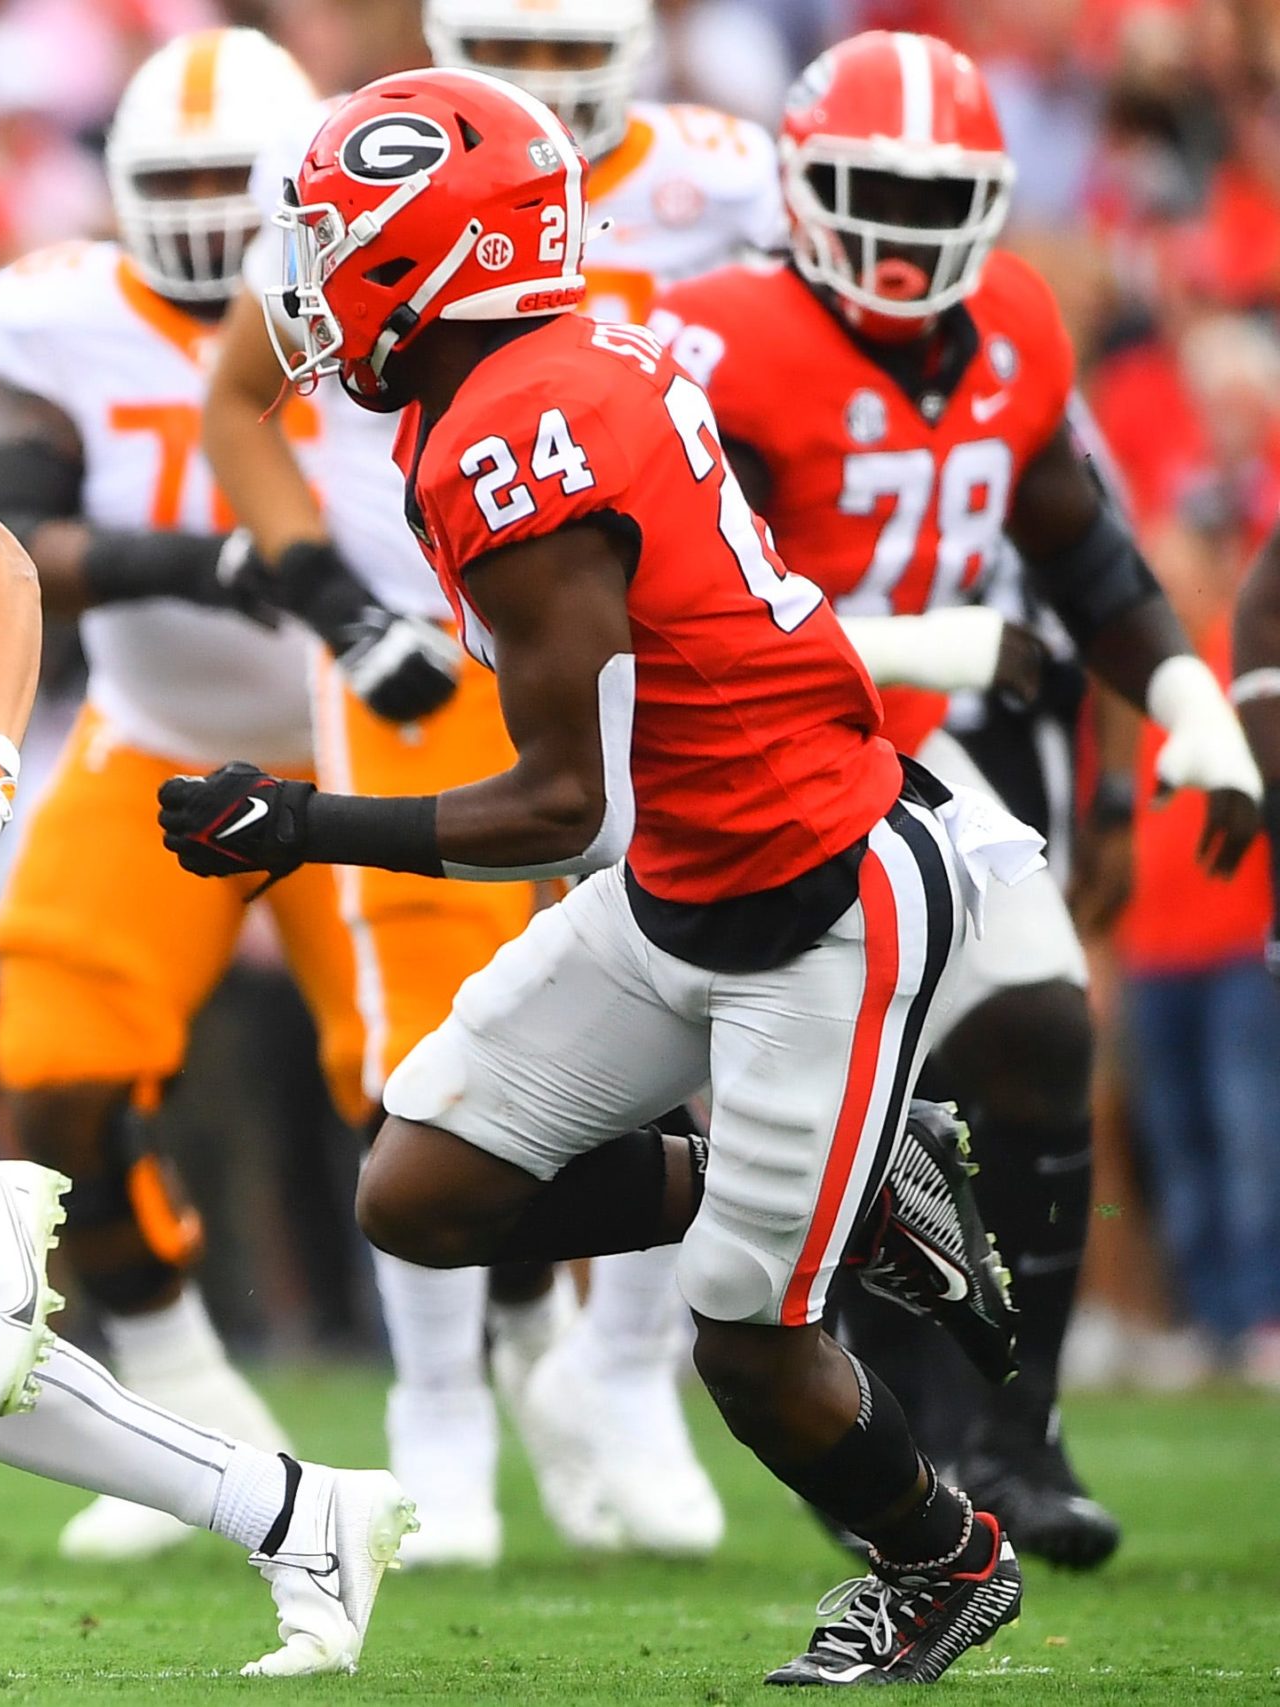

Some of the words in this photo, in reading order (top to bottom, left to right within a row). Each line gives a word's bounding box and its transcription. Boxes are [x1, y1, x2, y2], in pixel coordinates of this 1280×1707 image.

[340, 113, 450, 186] G
[482, 239, 509, 266] SEC
[459, 407, 595, 532] 24
[664, 373, 824, 634] 2
[834, 437, 1015, 616] 78
